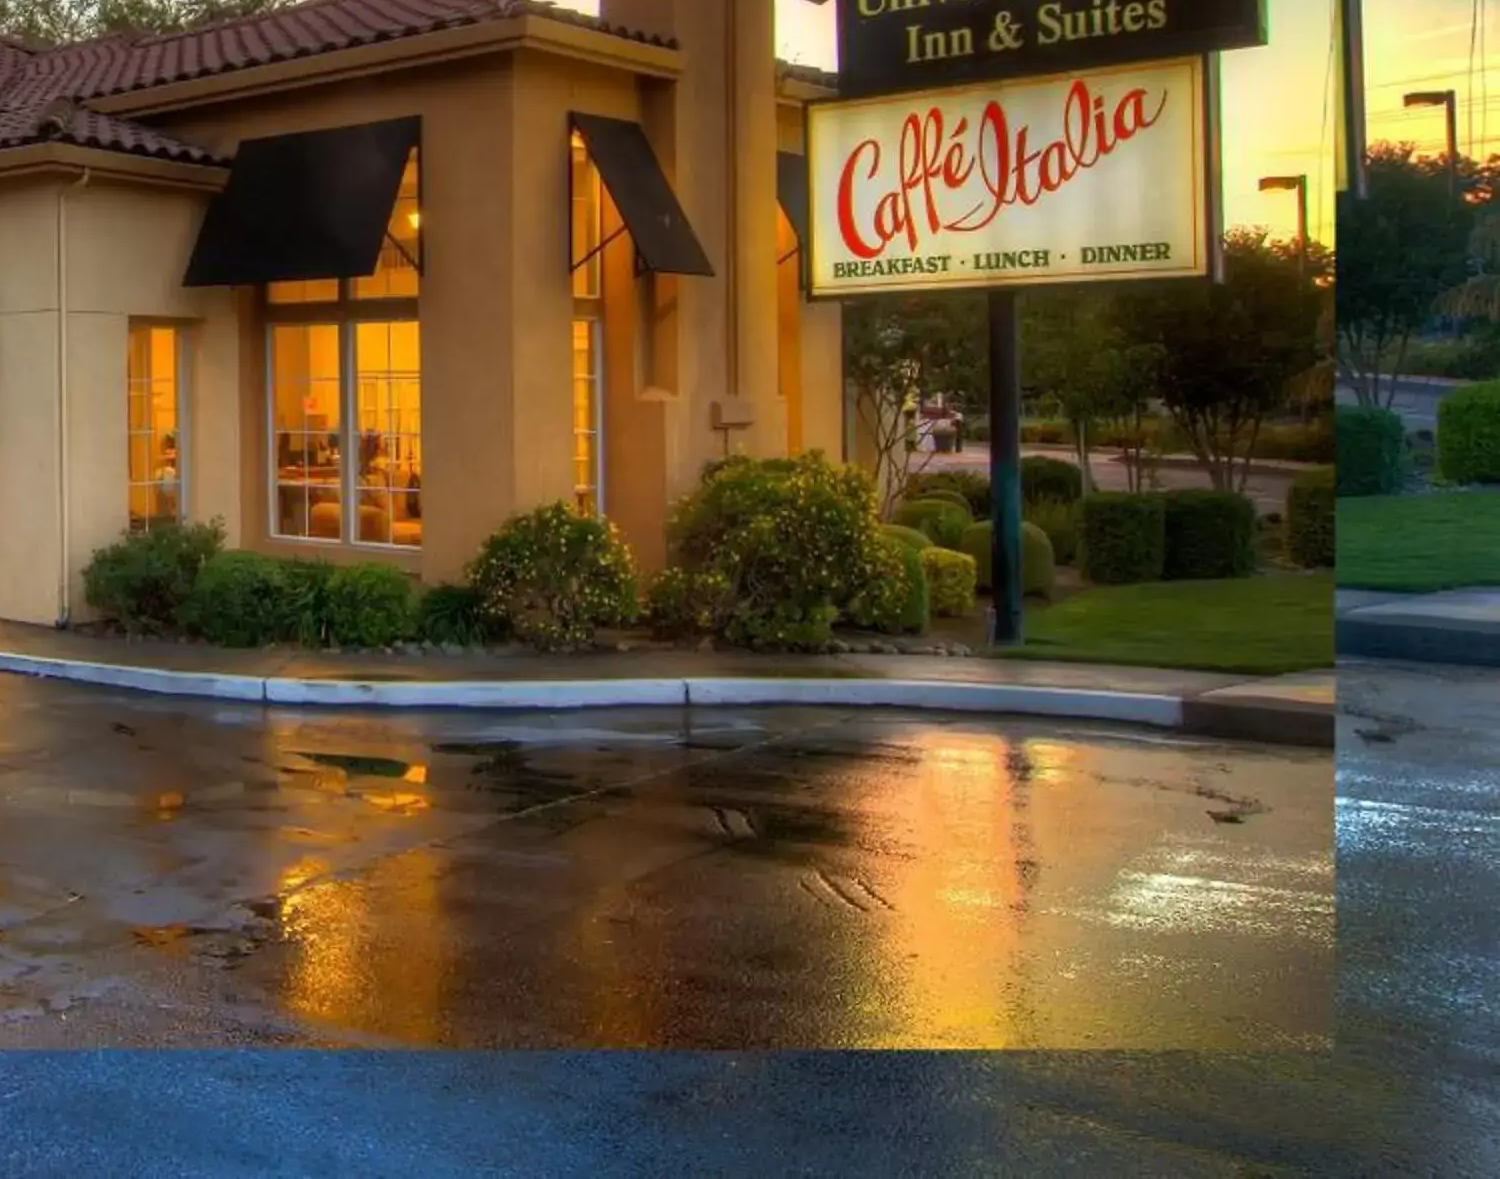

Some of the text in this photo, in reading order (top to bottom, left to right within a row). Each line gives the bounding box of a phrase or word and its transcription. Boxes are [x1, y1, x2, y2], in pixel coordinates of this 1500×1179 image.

[906, 25, 973, 63] Inn
[988, 11, 1024, 51] &
[837, 79, 1168, 259] Caffé Italia
[833, 242, 1171, 279] BREAKFAST LUNCH DINNER
